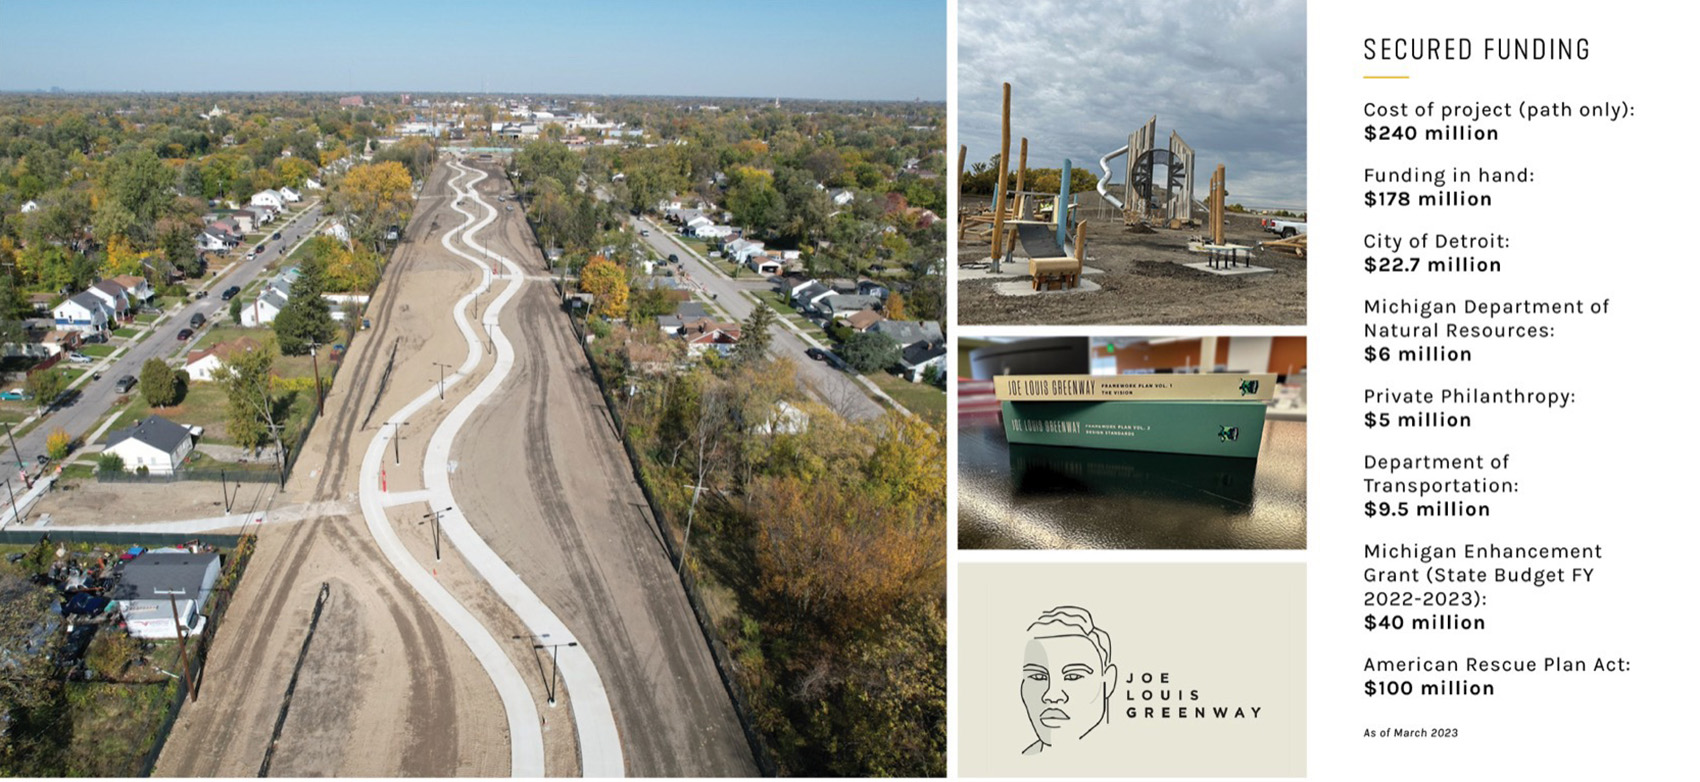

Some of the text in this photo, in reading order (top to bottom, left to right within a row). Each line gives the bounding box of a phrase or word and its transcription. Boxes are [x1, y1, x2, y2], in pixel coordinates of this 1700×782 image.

[1008, 380, 1096, 396] JOE LOUIS GREENWAY
[1011, 419, 1081, 433] JOE LOUIS GREENWAY
[1126, 673, 1170, 684] JOE
[1126, 690, 1199, 701] LOUIS
[1126, 707, 1261, 718] GREENWAY
